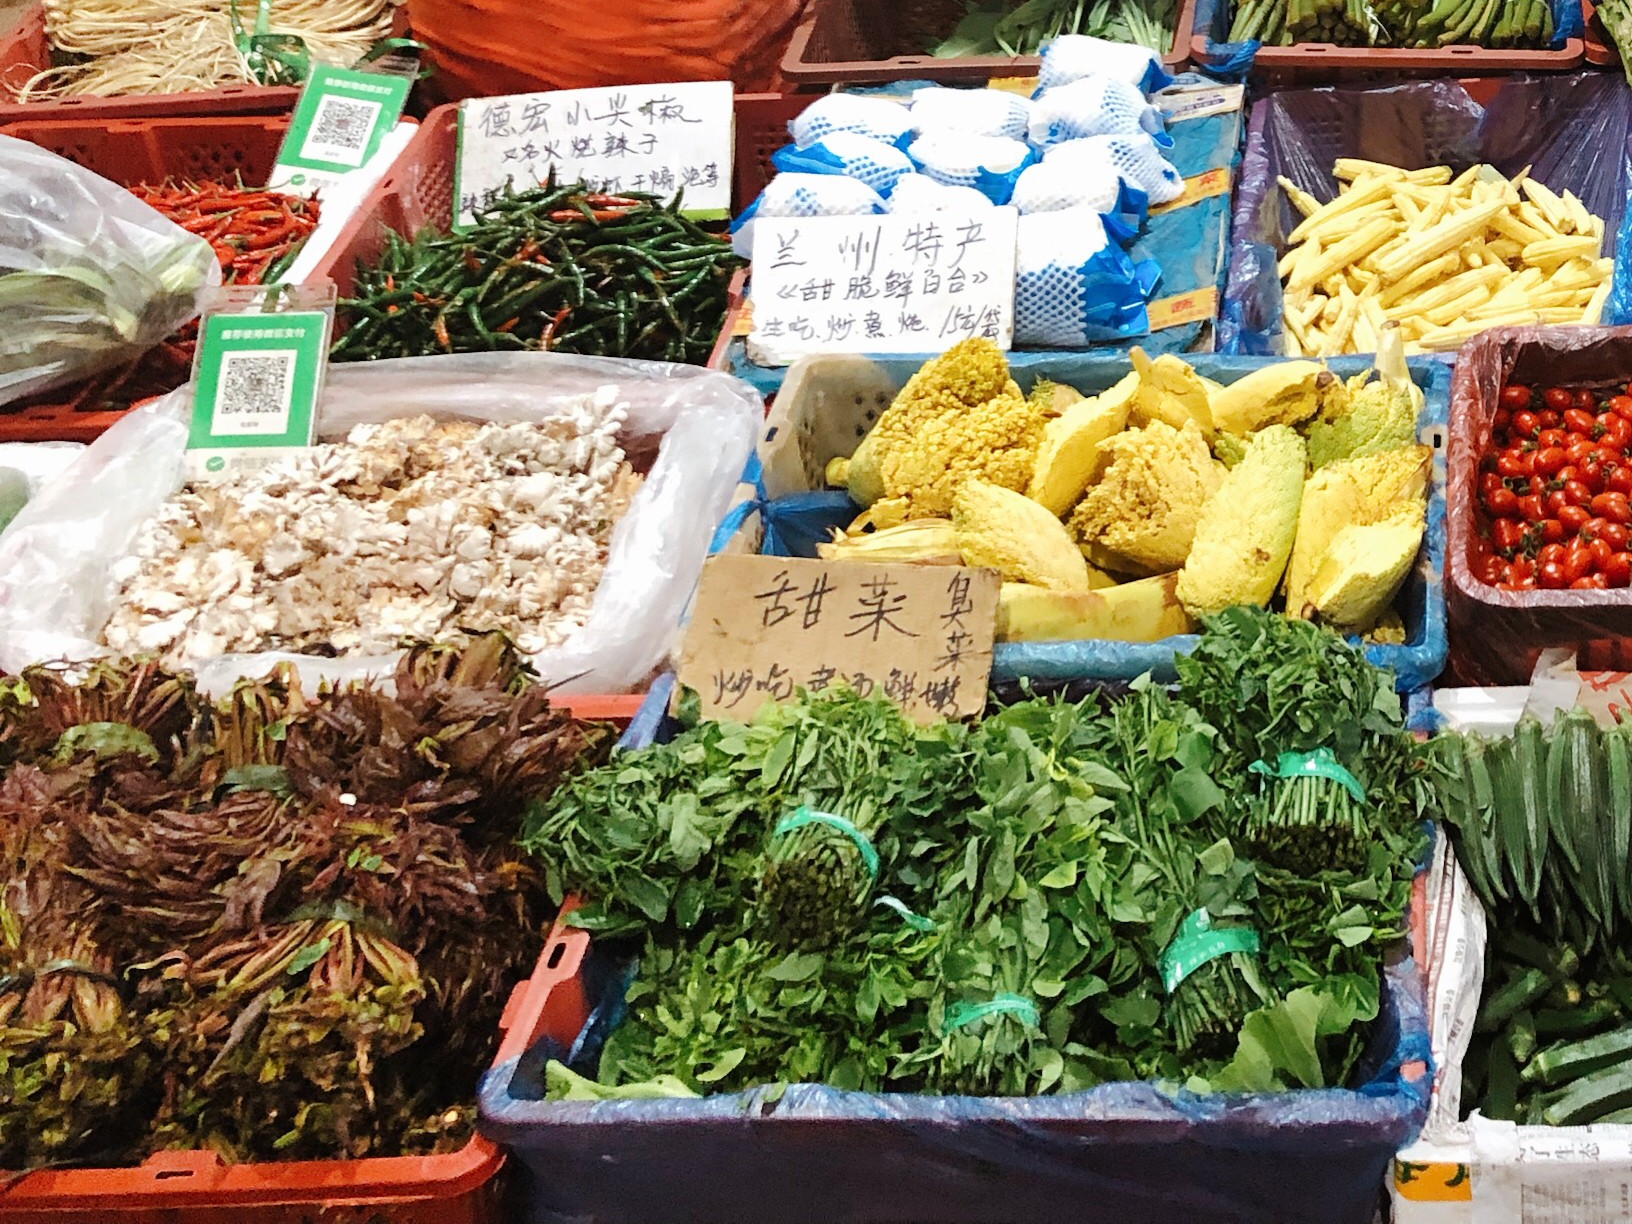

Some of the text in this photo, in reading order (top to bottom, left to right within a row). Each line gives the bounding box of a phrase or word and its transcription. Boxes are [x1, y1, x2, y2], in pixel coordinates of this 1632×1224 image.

[770, 219, 986, 275] 兰州特产
[754, 570, 921, 642] 甜菜
